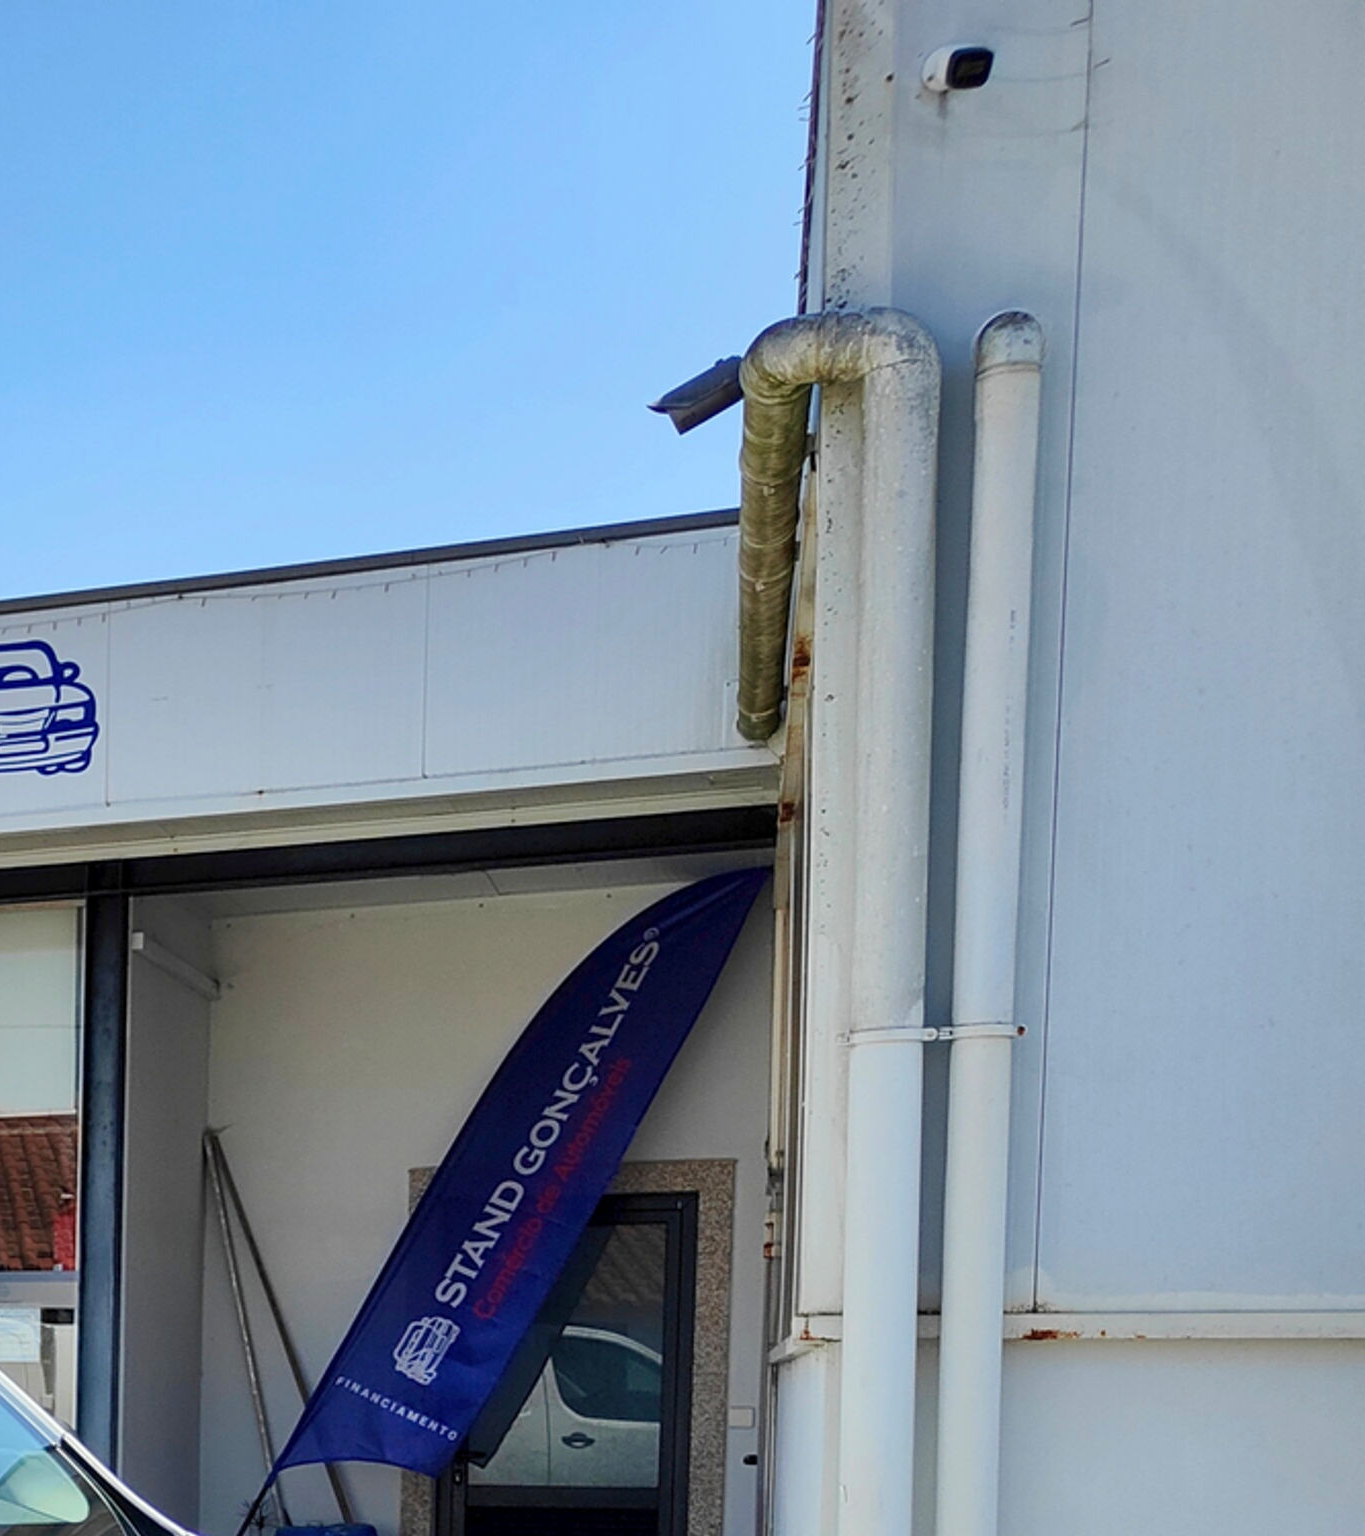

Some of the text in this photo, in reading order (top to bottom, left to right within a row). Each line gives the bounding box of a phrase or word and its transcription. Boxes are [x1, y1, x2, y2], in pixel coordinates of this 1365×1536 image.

[535, 1183, 562, 1213] de
[553, 1057, 633, 1181] Automóveis
[435, 1180, 526, 1308] STAND
[335, 1376, 459, 1441] FINANCIAMENTO
